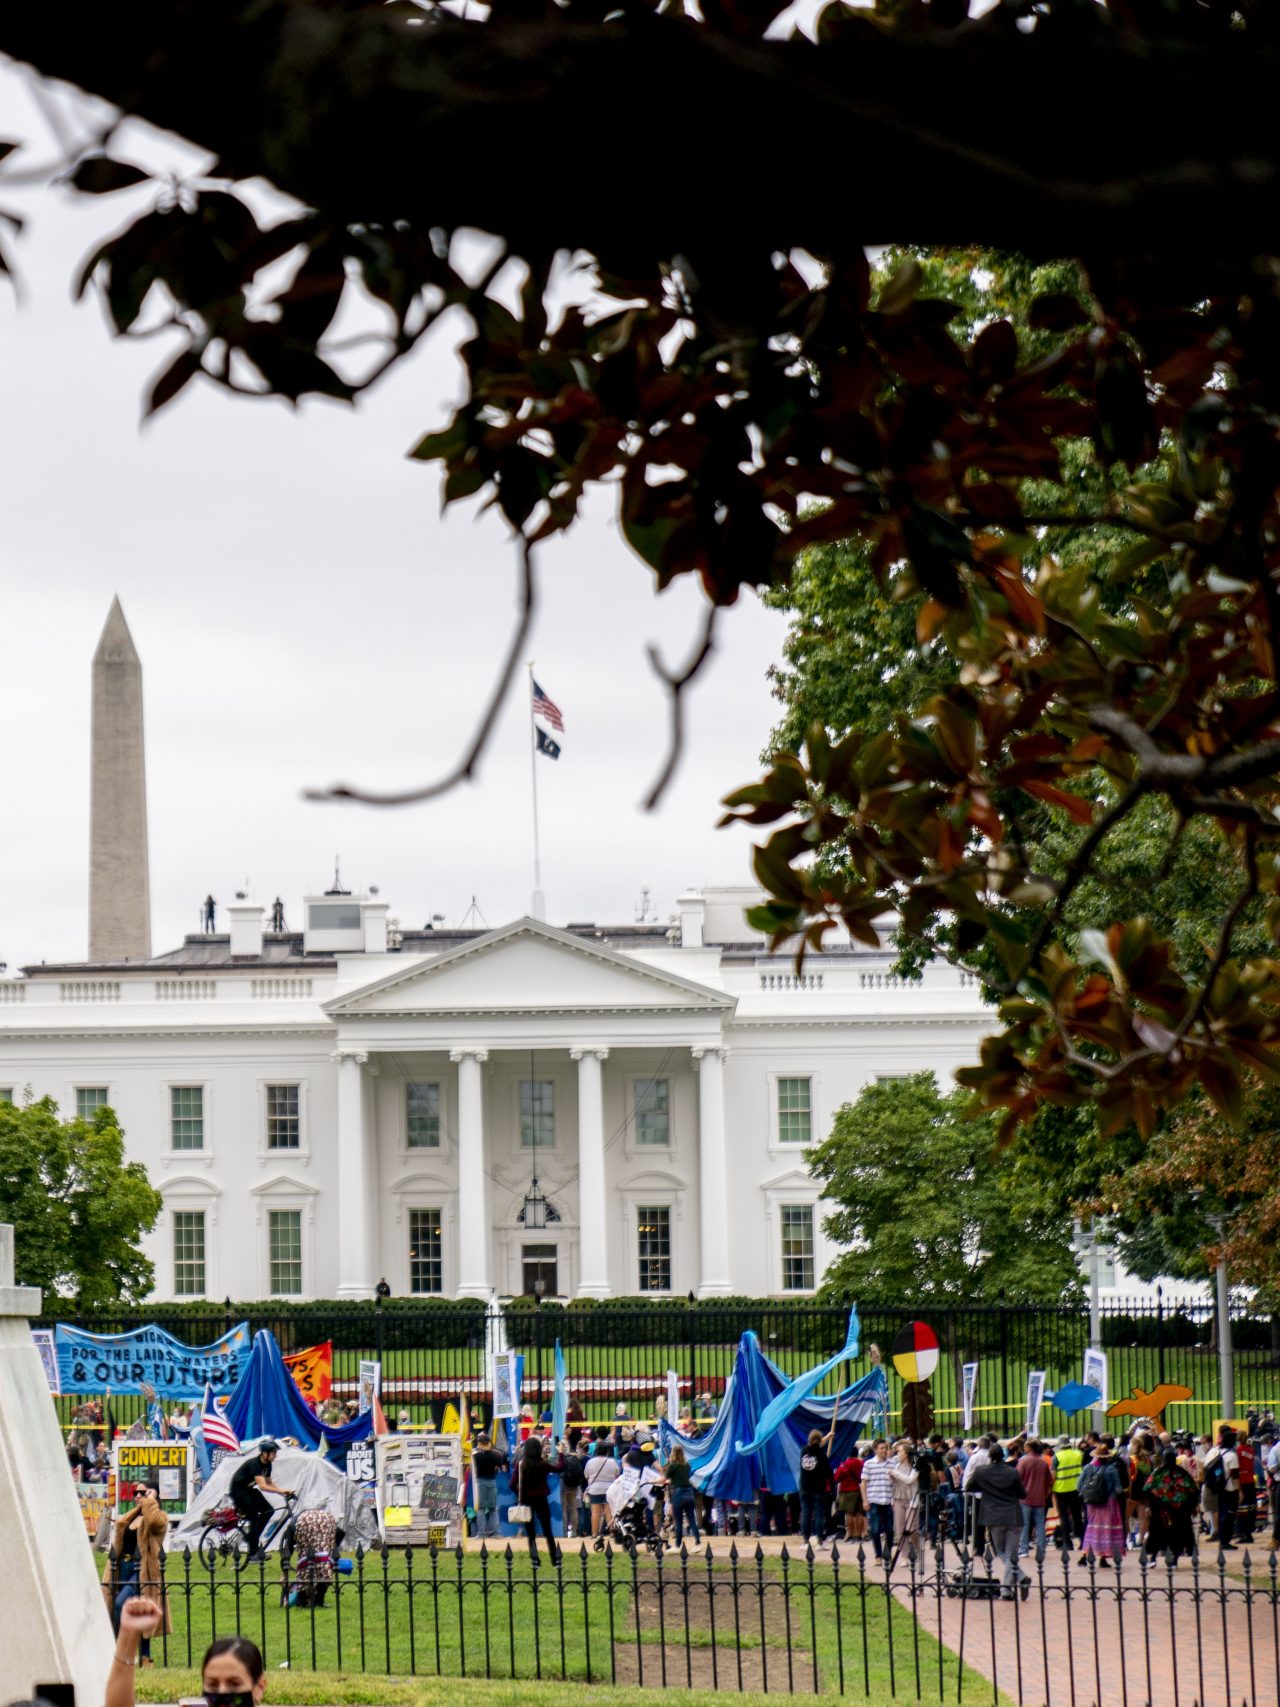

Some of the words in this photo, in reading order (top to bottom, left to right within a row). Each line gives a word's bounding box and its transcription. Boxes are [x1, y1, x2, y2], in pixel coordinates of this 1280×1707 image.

[71, 1347, 98, 1361] FOR
[105, 1348, 130, 1362] THE
[181, 1349, 238, 1367] WATERS
[71, 1361, 87, 1383] &
[94, 1361, 146, 1384] OUR
[153, 1363, 240, 1386] FUTURE
[346, 1450, 373, 1460] ABOUT
[351, 1442, 367, 1451] IT'S
[118, 1447, 187, 1466] CONVERT
[119, 1466, 149, 1481] THE
[346, 1458, 376, 1481] US
